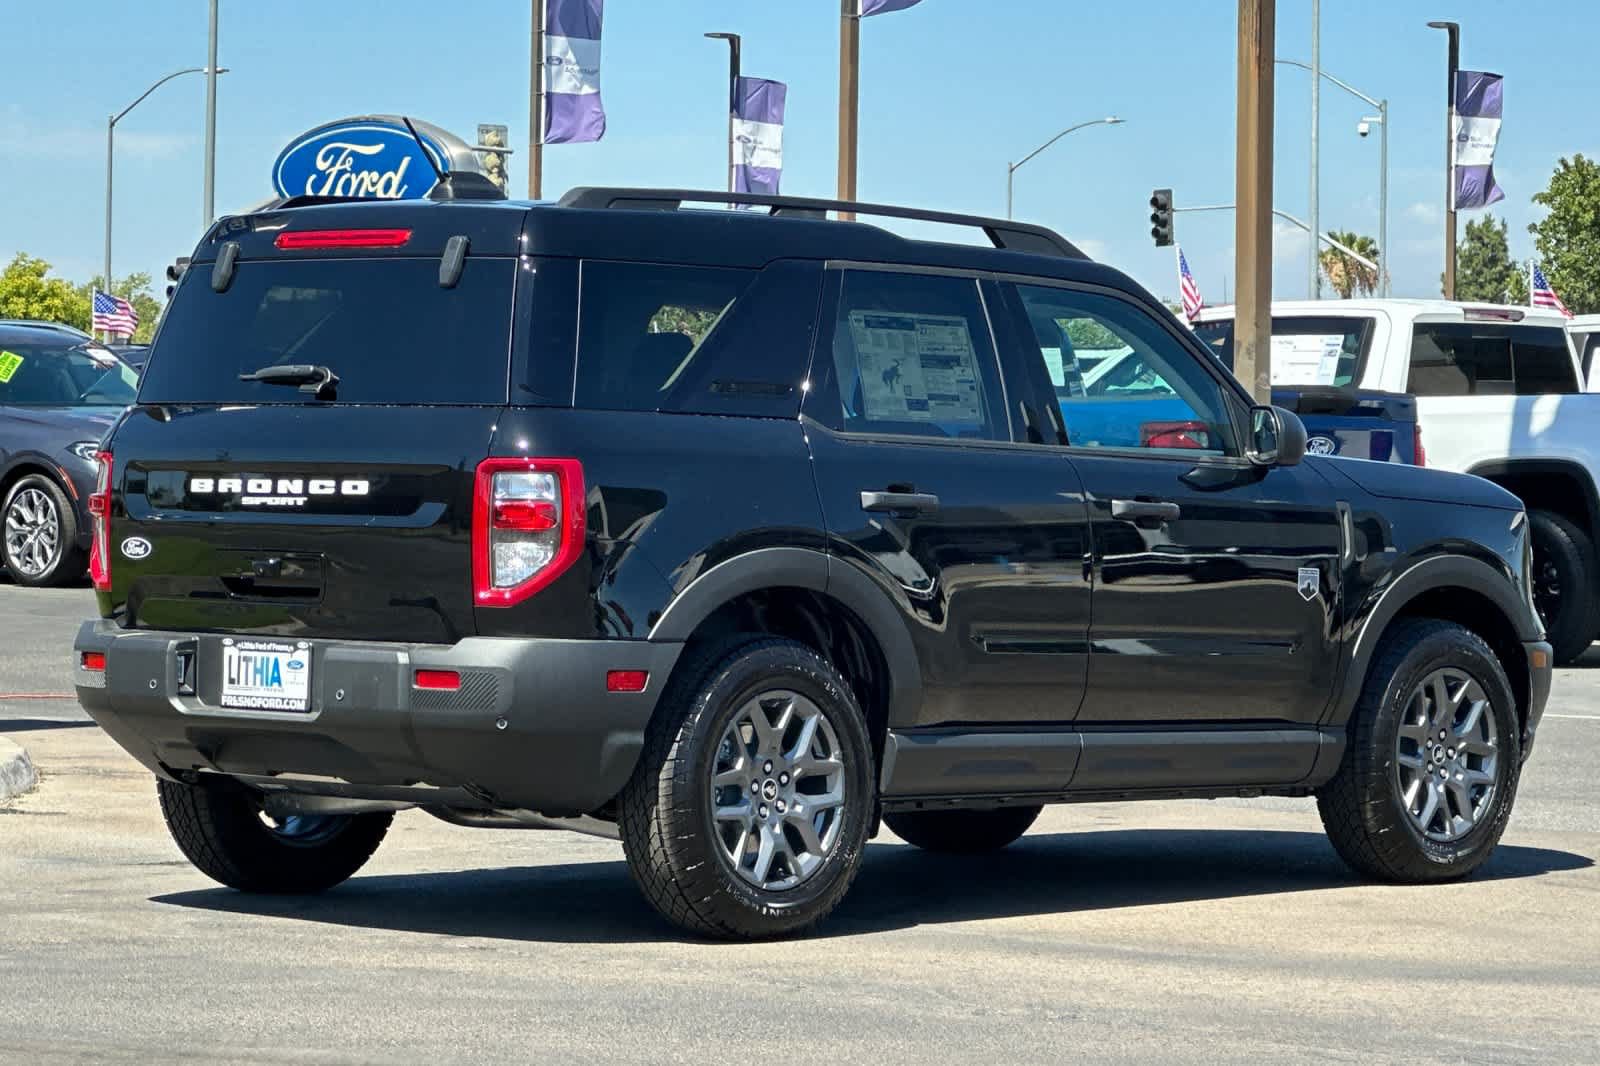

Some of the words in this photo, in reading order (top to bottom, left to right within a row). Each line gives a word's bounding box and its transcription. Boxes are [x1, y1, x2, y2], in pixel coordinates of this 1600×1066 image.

[305, 142, 412, 198] Ford
[190, 478, 369, 495] BRONCO
[241, 497, 308, 506] SPORT
[228, 655, 282, 687] LITHIA
